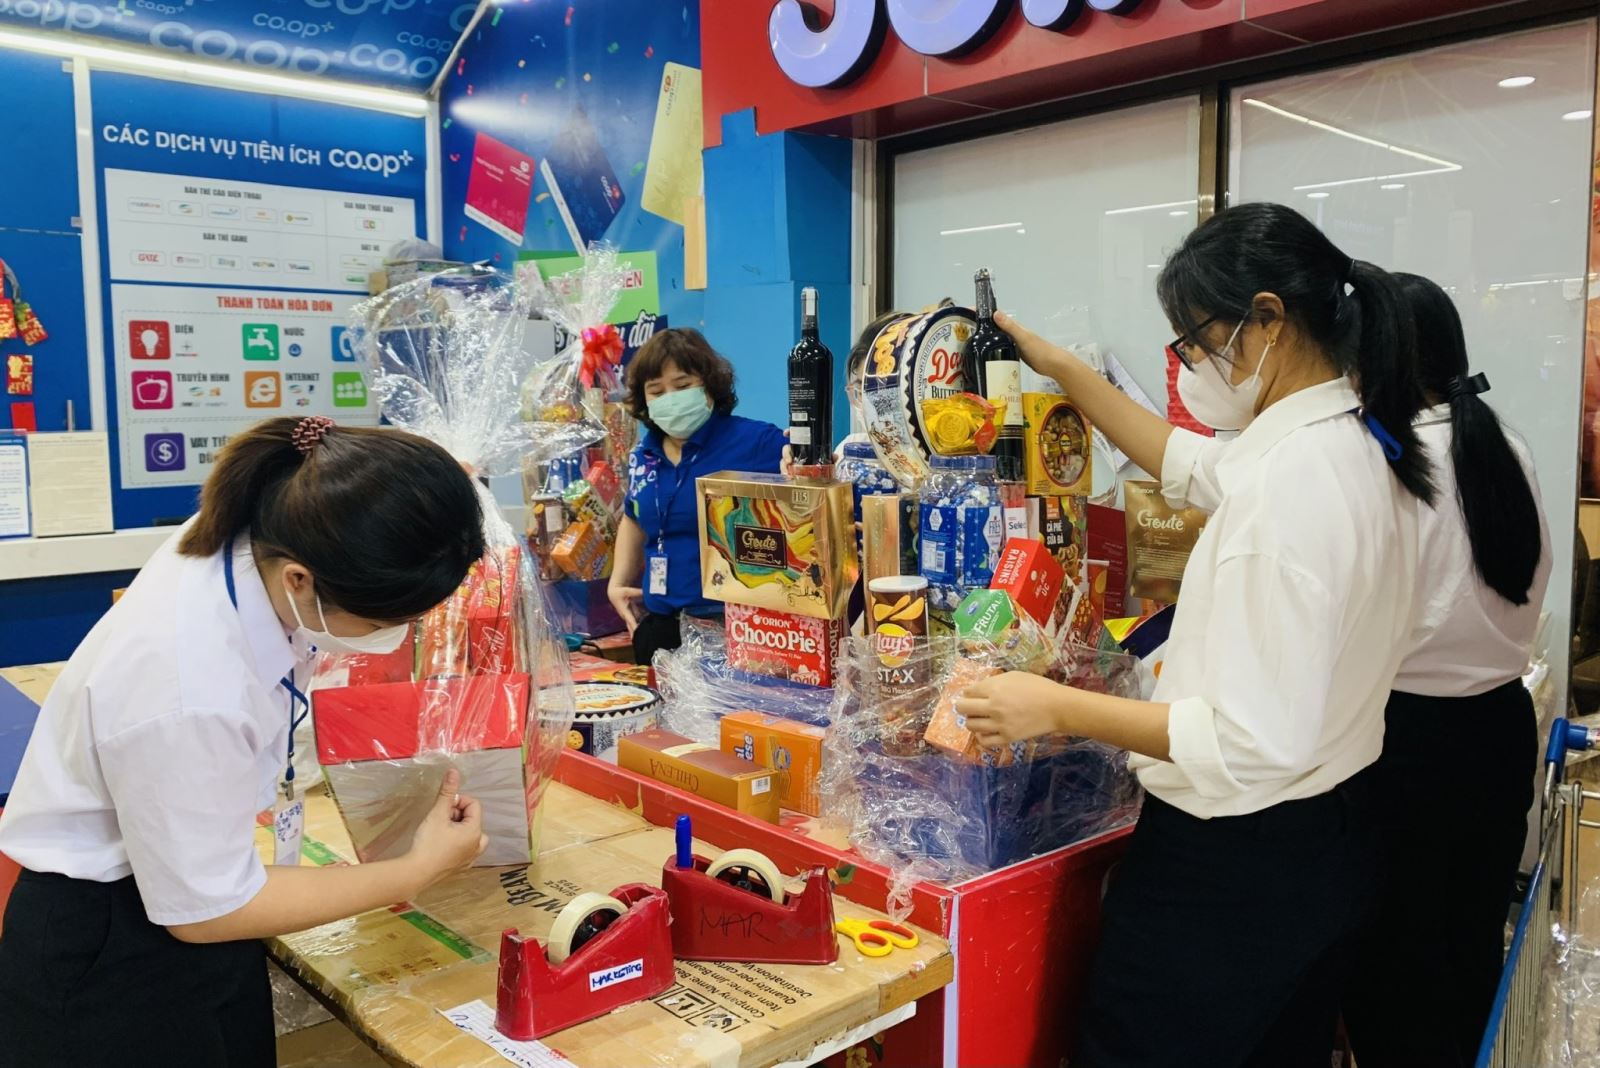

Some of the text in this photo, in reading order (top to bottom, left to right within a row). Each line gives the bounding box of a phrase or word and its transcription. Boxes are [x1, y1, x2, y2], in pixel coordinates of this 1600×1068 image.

[103, 123, 149, 146] CÁC
[155, 131, 206, 154] DỊCH
[209, 137, 237, 160] VỤ
[240, 140, 284, 164] TIỆN
[289, 144, 321, 166] ÍCH
[216, 296, 253, 309] THANH
[256, 297, 284, 310] TOÁN
[285, 372, 320, 381] INTERNET
[190, 437, 208, 448] VAY
[998, 548, 1020, 584] RAISINS
[762, 616, 791, 629] ORION
[877, 667, 915, 684] STAX
[649, 758, 699, 792] CHILENA
[500, 866, 549, 906] BEAM
[543, 880, 577, 897] SINCE
[699, 906, 777, 944] MAR
[711, 972, 731, 983] Jim
[736, 972, 757, 983] per
[753, 967, 813, 999] Destination:
[675, 967, 765, 1018] Company Name: Bea
[727, 981, 758, 998] name:
[753, 981, 797, 1005] Quantity
[757, 997, 782, 1012] Item
